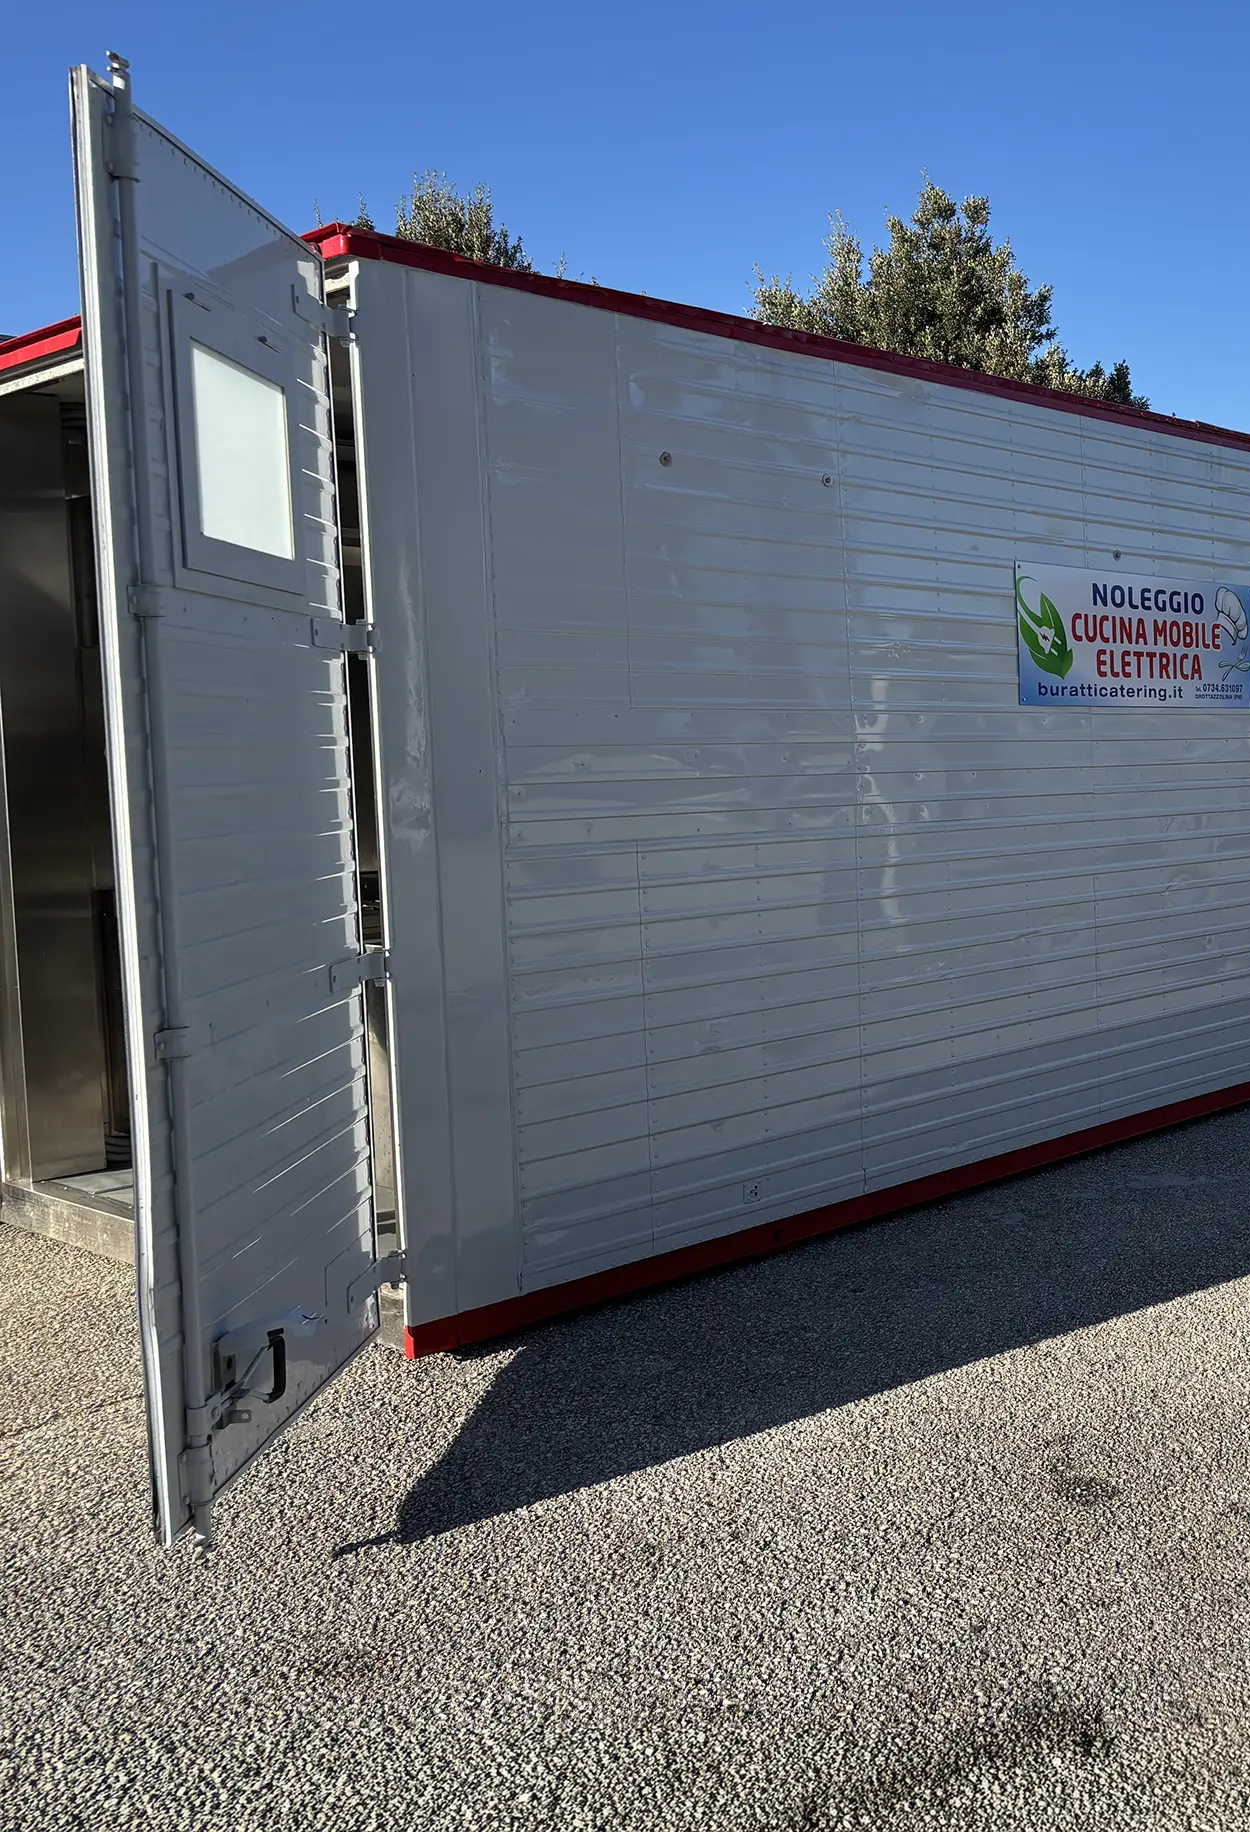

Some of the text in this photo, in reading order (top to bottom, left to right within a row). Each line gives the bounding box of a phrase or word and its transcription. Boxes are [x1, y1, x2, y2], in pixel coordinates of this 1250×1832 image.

[1092, 582, 1205, 615] NOLEGGIO
[1071, 612, 1221, 650] CUCINA MOBILE
[1096, 648, 1203, 681] ELETTRICA
[1037, 681, 1184, 702] buratticatering.it
[1202, 683, 1243, 693] 0734.631097
